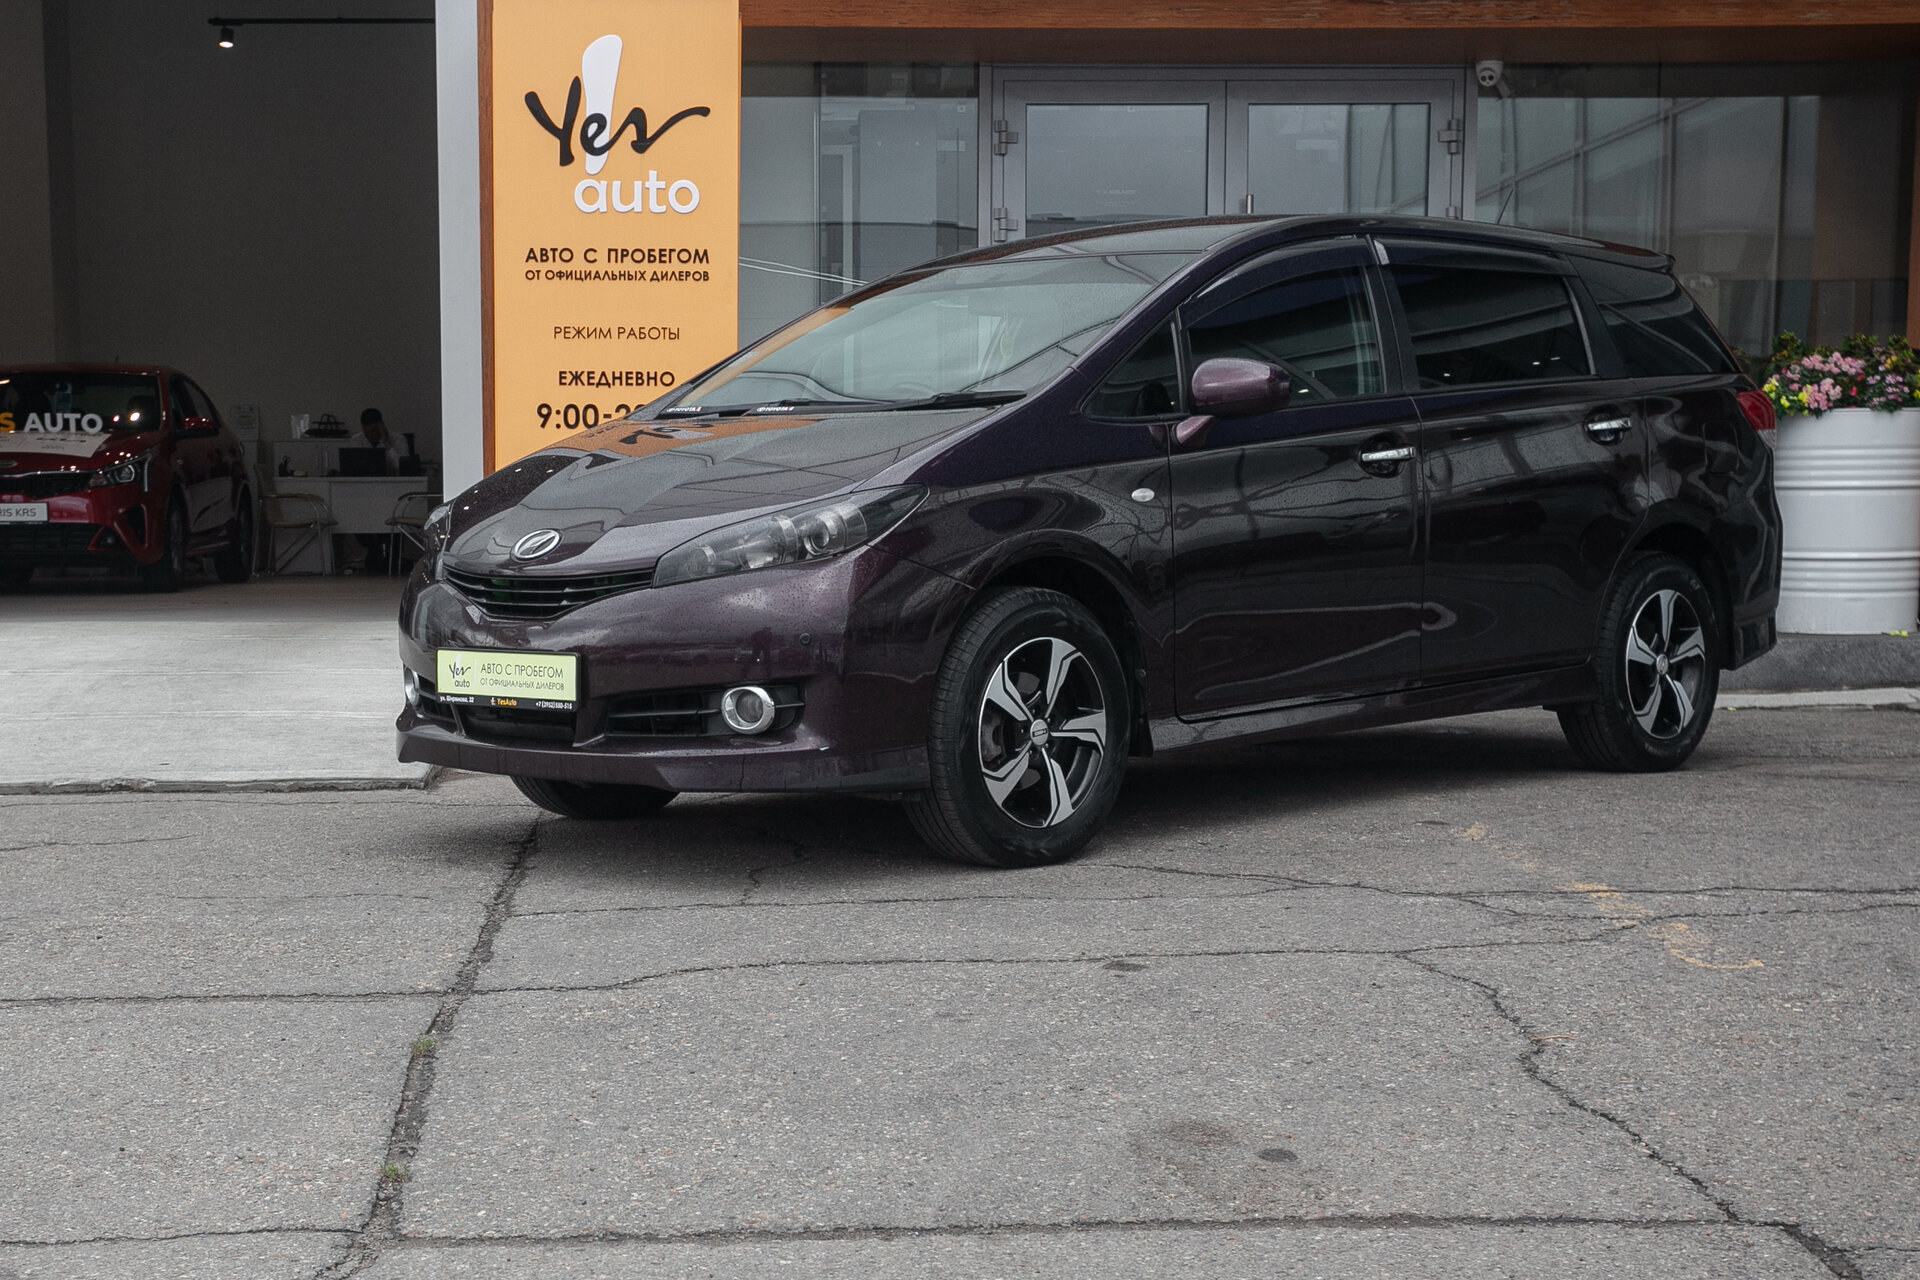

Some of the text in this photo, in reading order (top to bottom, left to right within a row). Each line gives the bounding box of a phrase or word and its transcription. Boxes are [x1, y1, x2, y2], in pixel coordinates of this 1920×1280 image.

[574, 170, 700, 214] auto
[525, 248, 710, 264] АВТО С ПРОБЕГОМ
[525, 270, 710, 282] ОТ ОФИЦИАЛЬНЫХ ДИЛЕРОВ
[553, 326, 680, 340] РЕЖИМ РАБОТЫ
[558, 371, 675, 388] ЕЖЕДНЕВНО
[23, 412, 103, 435] AUTO
[15, 508, 37, 517] KRS
[480, 663, 564, 678] АВТО С ПРОБЕГОМ
[454, 679, 471, 688] auto
[480, 677, 565, 690] ОТ ОФИЦИАЛЬНЫХ ДИЛЕРОВ
